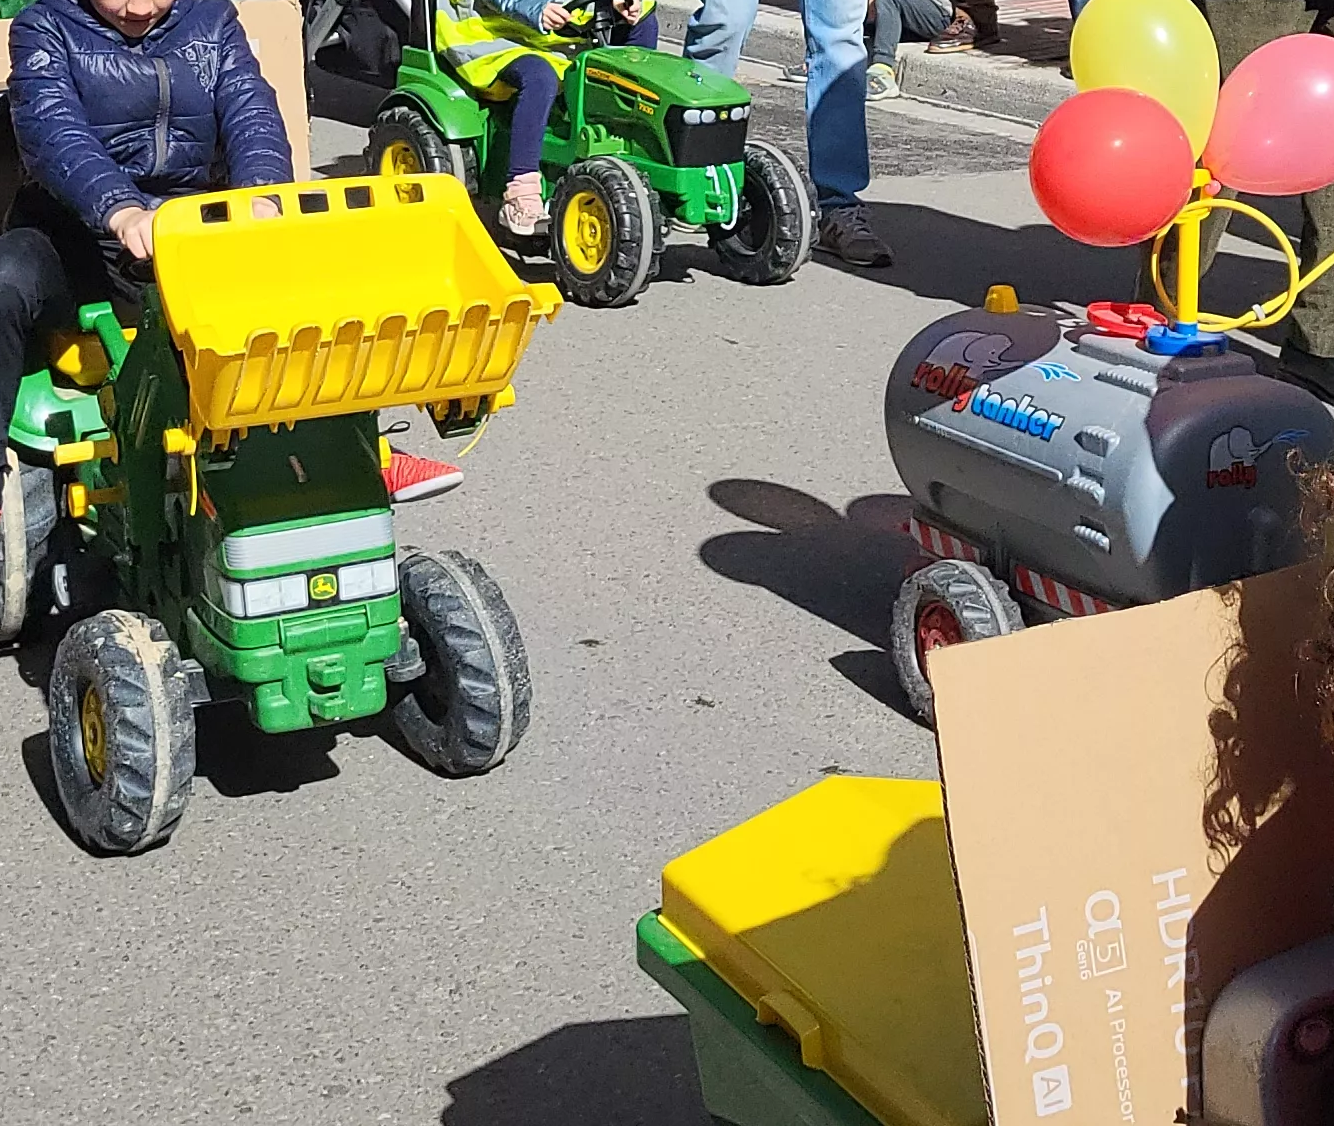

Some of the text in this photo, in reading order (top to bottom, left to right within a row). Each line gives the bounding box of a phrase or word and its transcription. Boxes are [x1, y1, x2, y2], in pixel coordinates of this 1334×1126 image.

[1206, 462, 1258, 489] rolly
[1076, 939, 1092, 981] Gen6
[1012, 905, 1064, 1065] ThinQ
[1105, 989, 1135, 1124] AI Processor
[1037, 1073, 1069, 1114] AI
